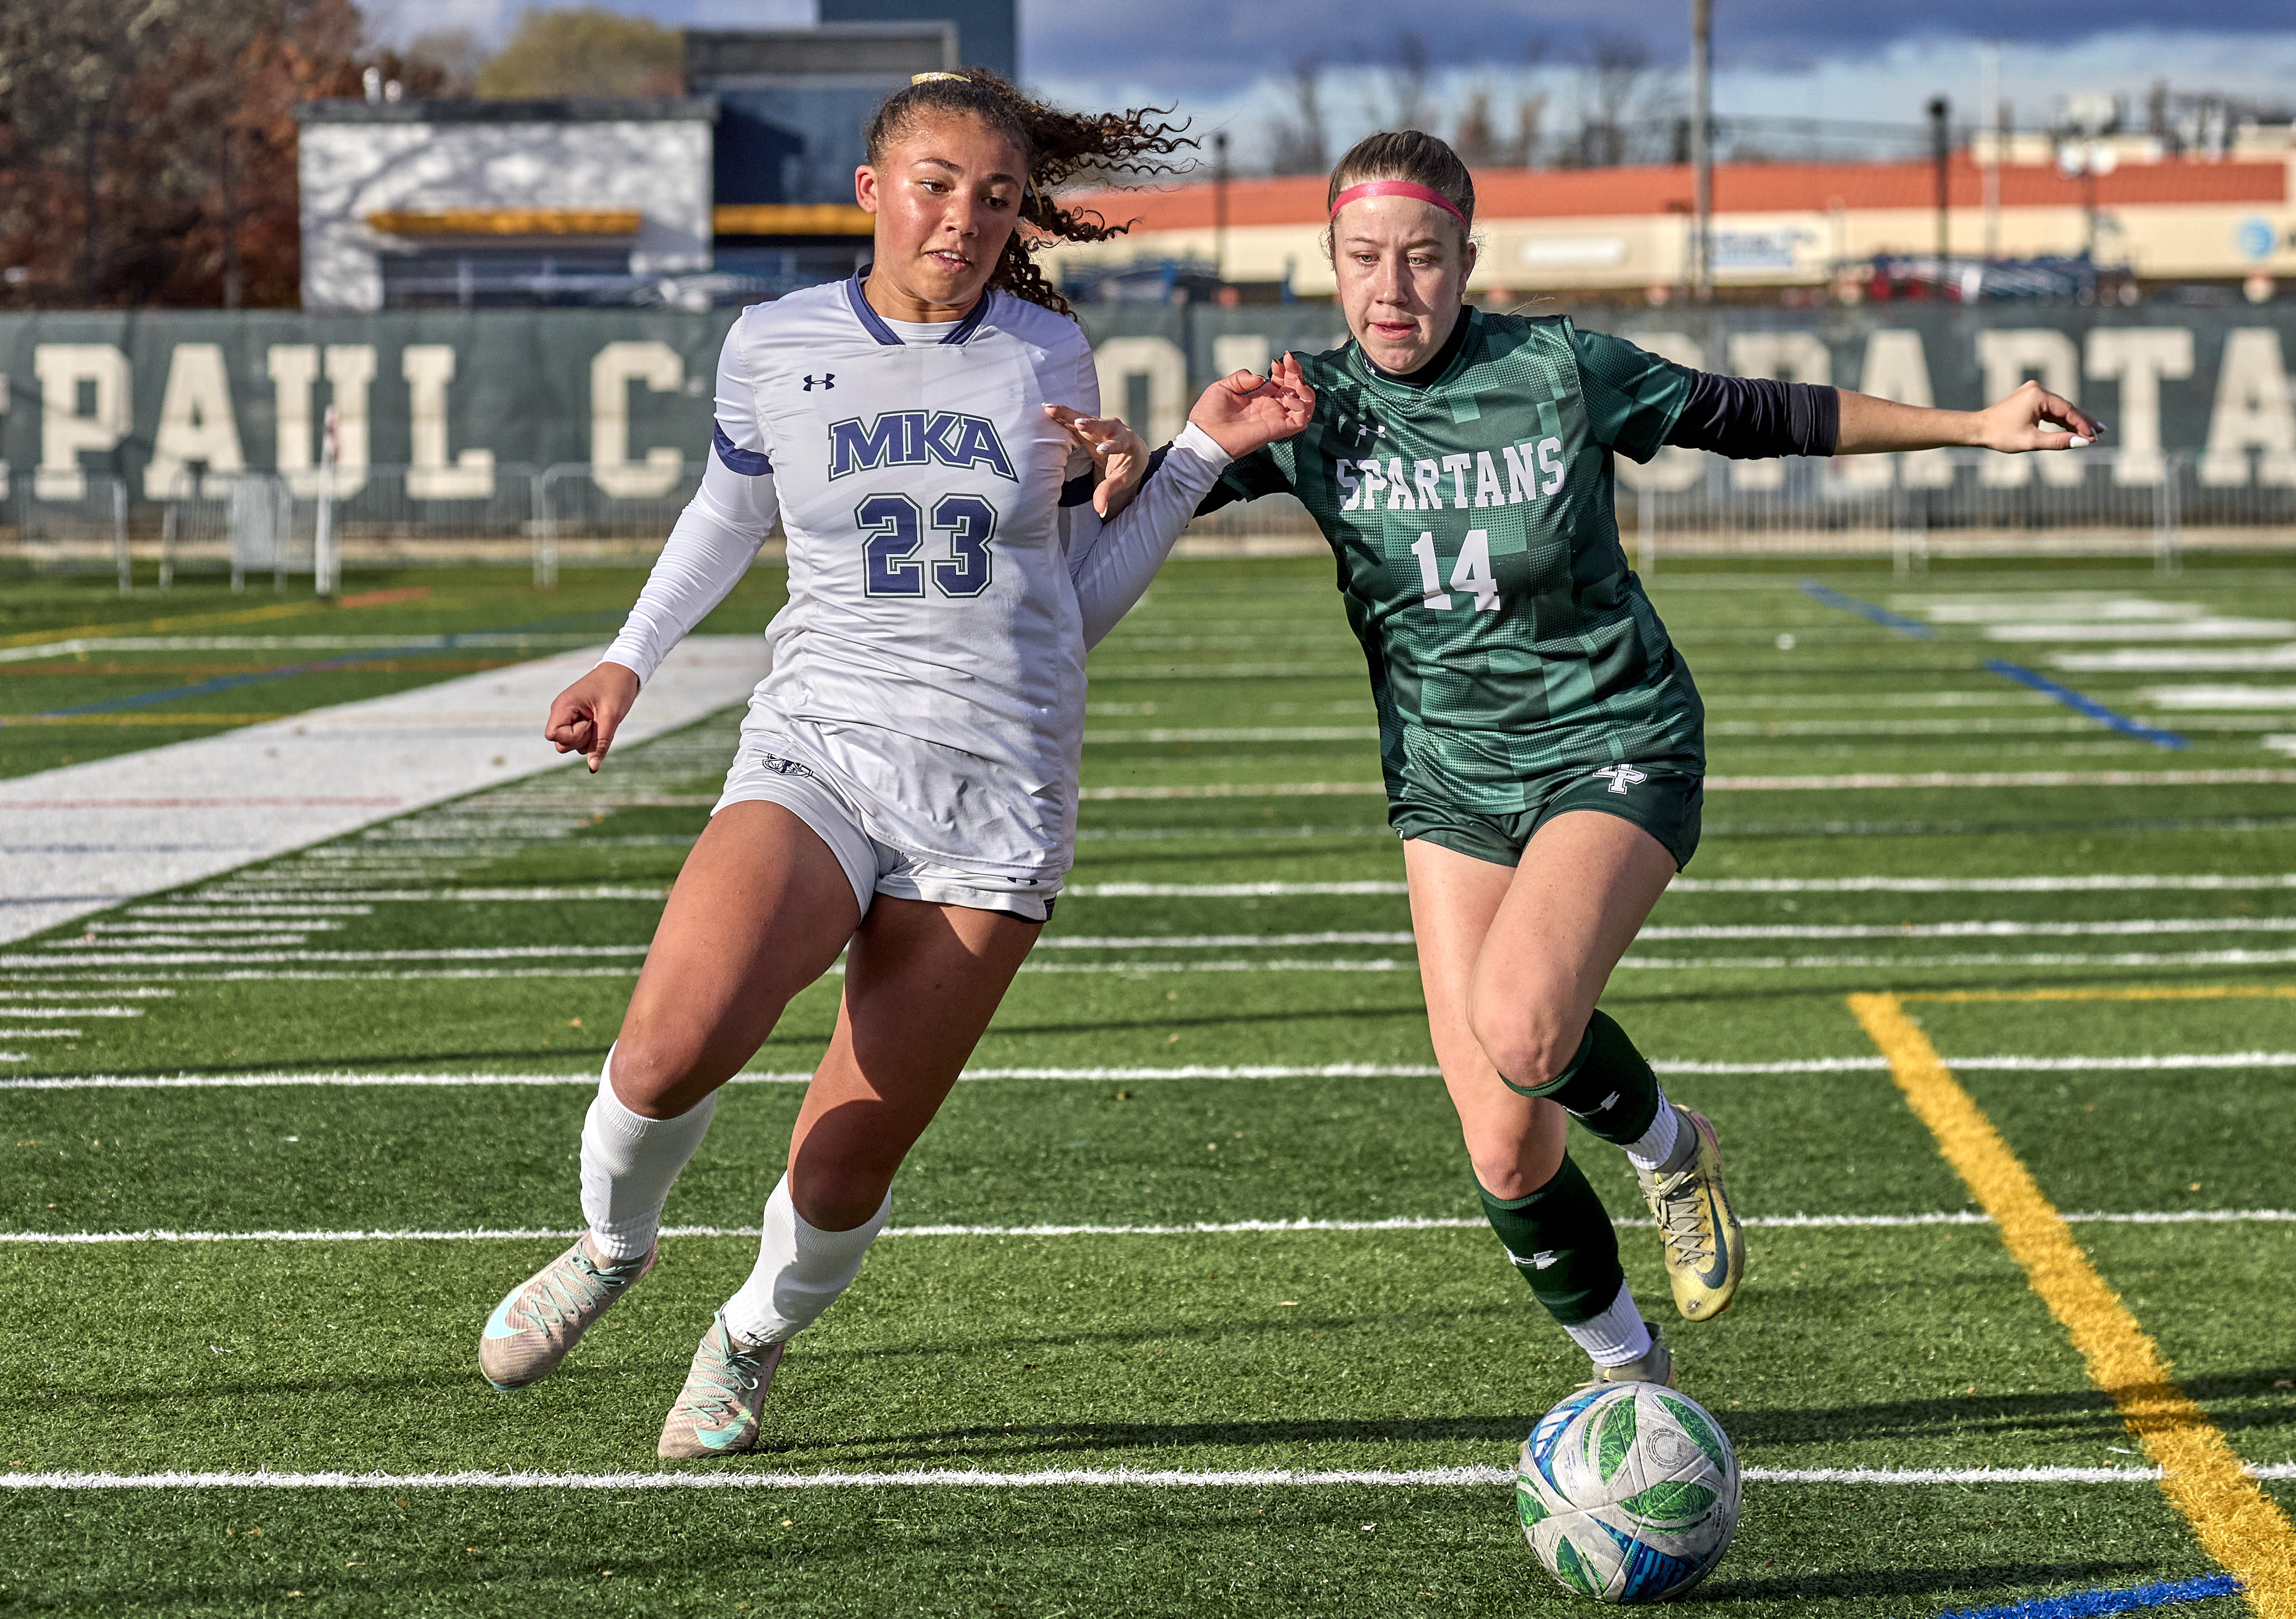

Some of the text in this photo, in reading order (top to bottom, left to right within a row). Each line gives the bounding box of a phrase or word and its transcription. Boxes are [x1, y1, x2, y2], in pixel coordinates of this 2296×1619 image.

[0, 342, 496, 500] PAUL
[828, 409, 1019, 484] MKA
[1336, 436, 1565, 511] SPARTANS
[853, 492, 998, 599] 23
[1411, 528, 1501, 613] 14
